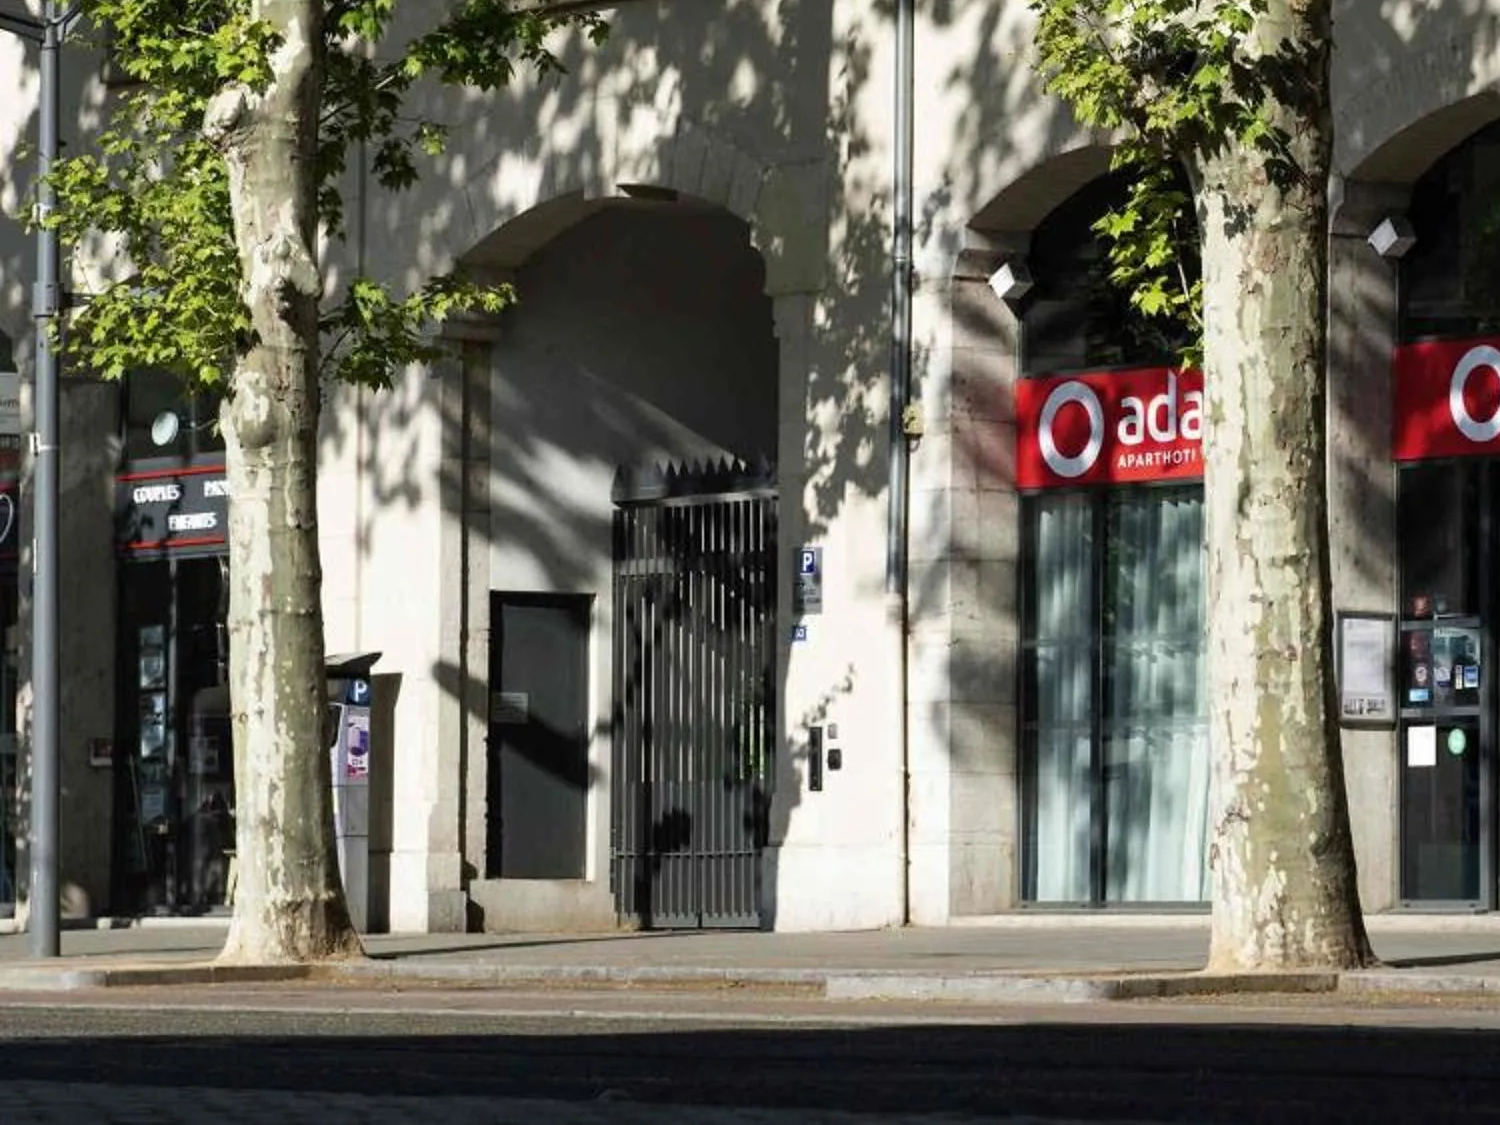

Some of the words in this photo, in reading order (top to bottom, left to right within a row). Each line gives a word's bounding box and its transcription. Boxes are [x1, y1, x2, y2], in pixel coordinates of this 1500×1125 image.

[1117, 368, 1204, 446] ada
[803, 551, 813, 572] P
[354, 678, 368, 702] P
